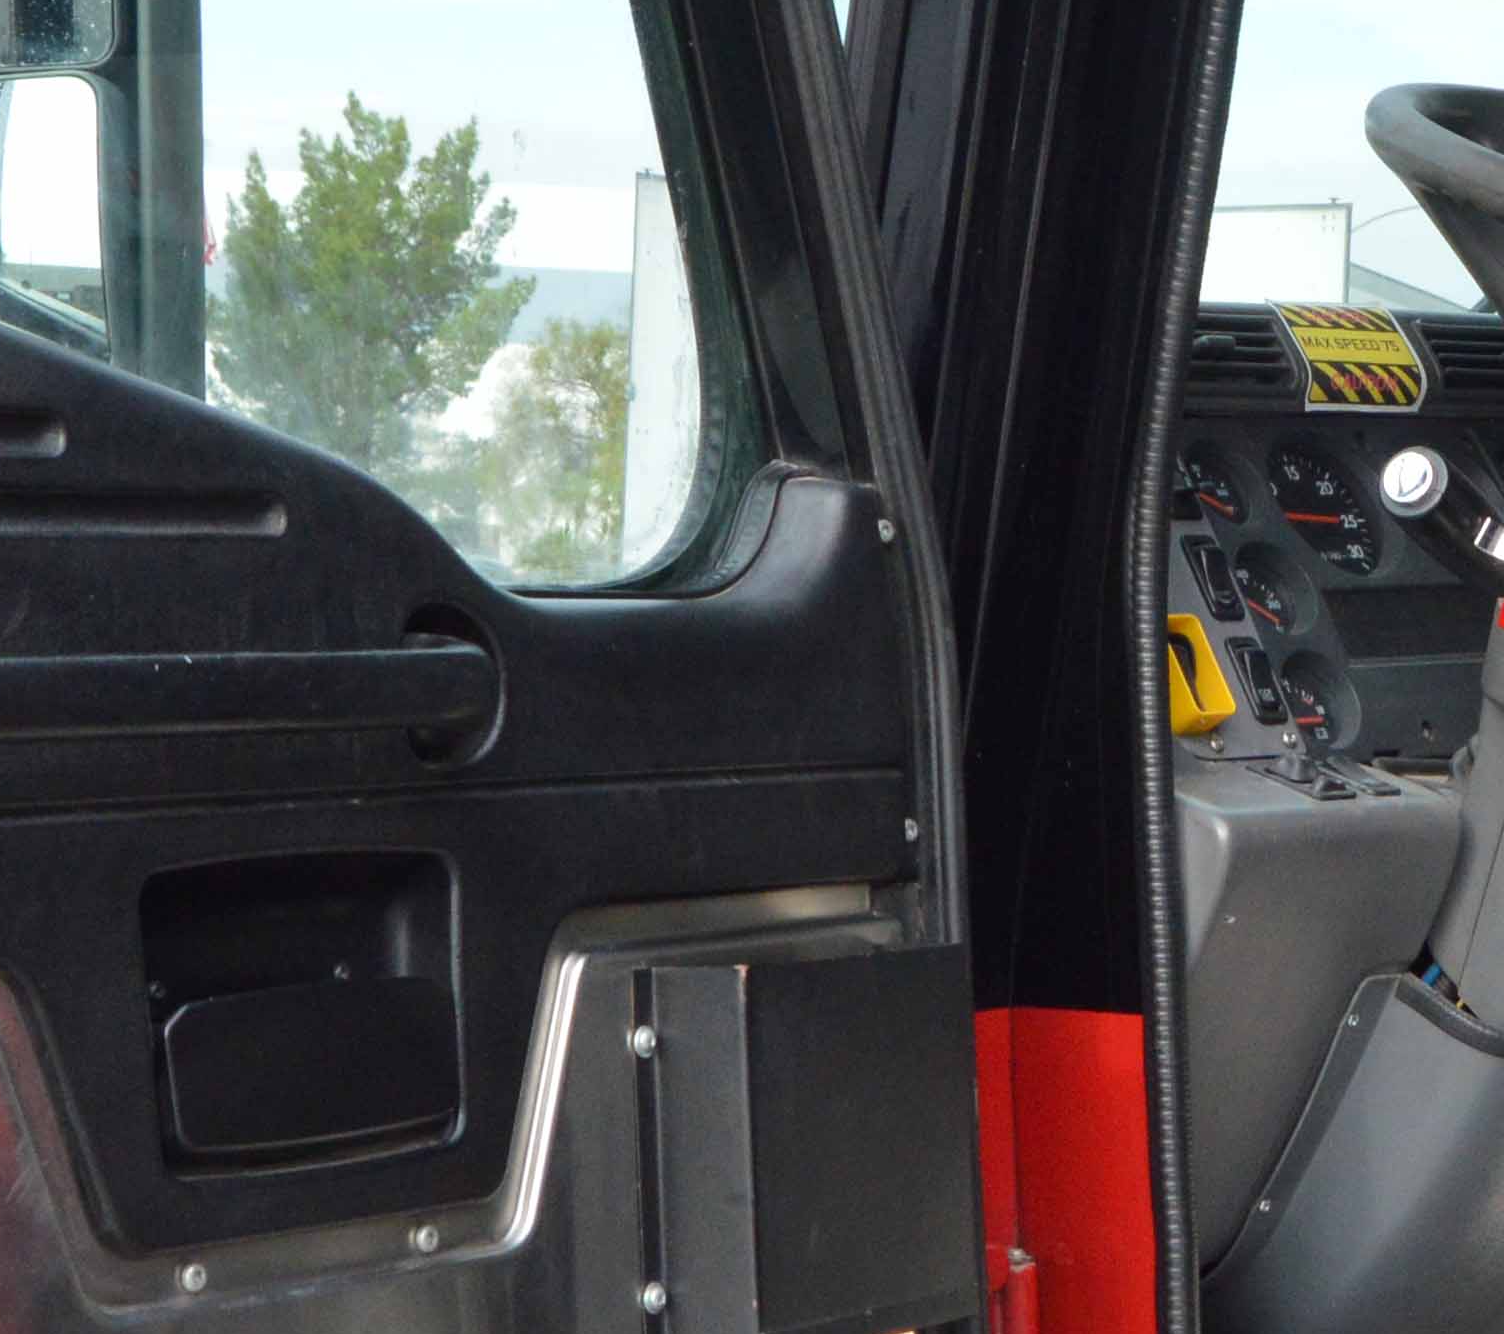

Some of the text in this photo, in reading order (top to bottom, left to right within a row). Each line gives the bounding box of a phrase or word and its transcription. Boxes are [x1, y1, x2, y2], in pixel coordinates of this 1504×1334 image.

[1300, 336, 1400, 352] MAX SPEED 75
[1284, 466, 1300, 480] 15
[1316, 481, 1334, 495] 20
[1340, 514, 1358, 528] 25
[1347, 544, 1364, 558] 30
